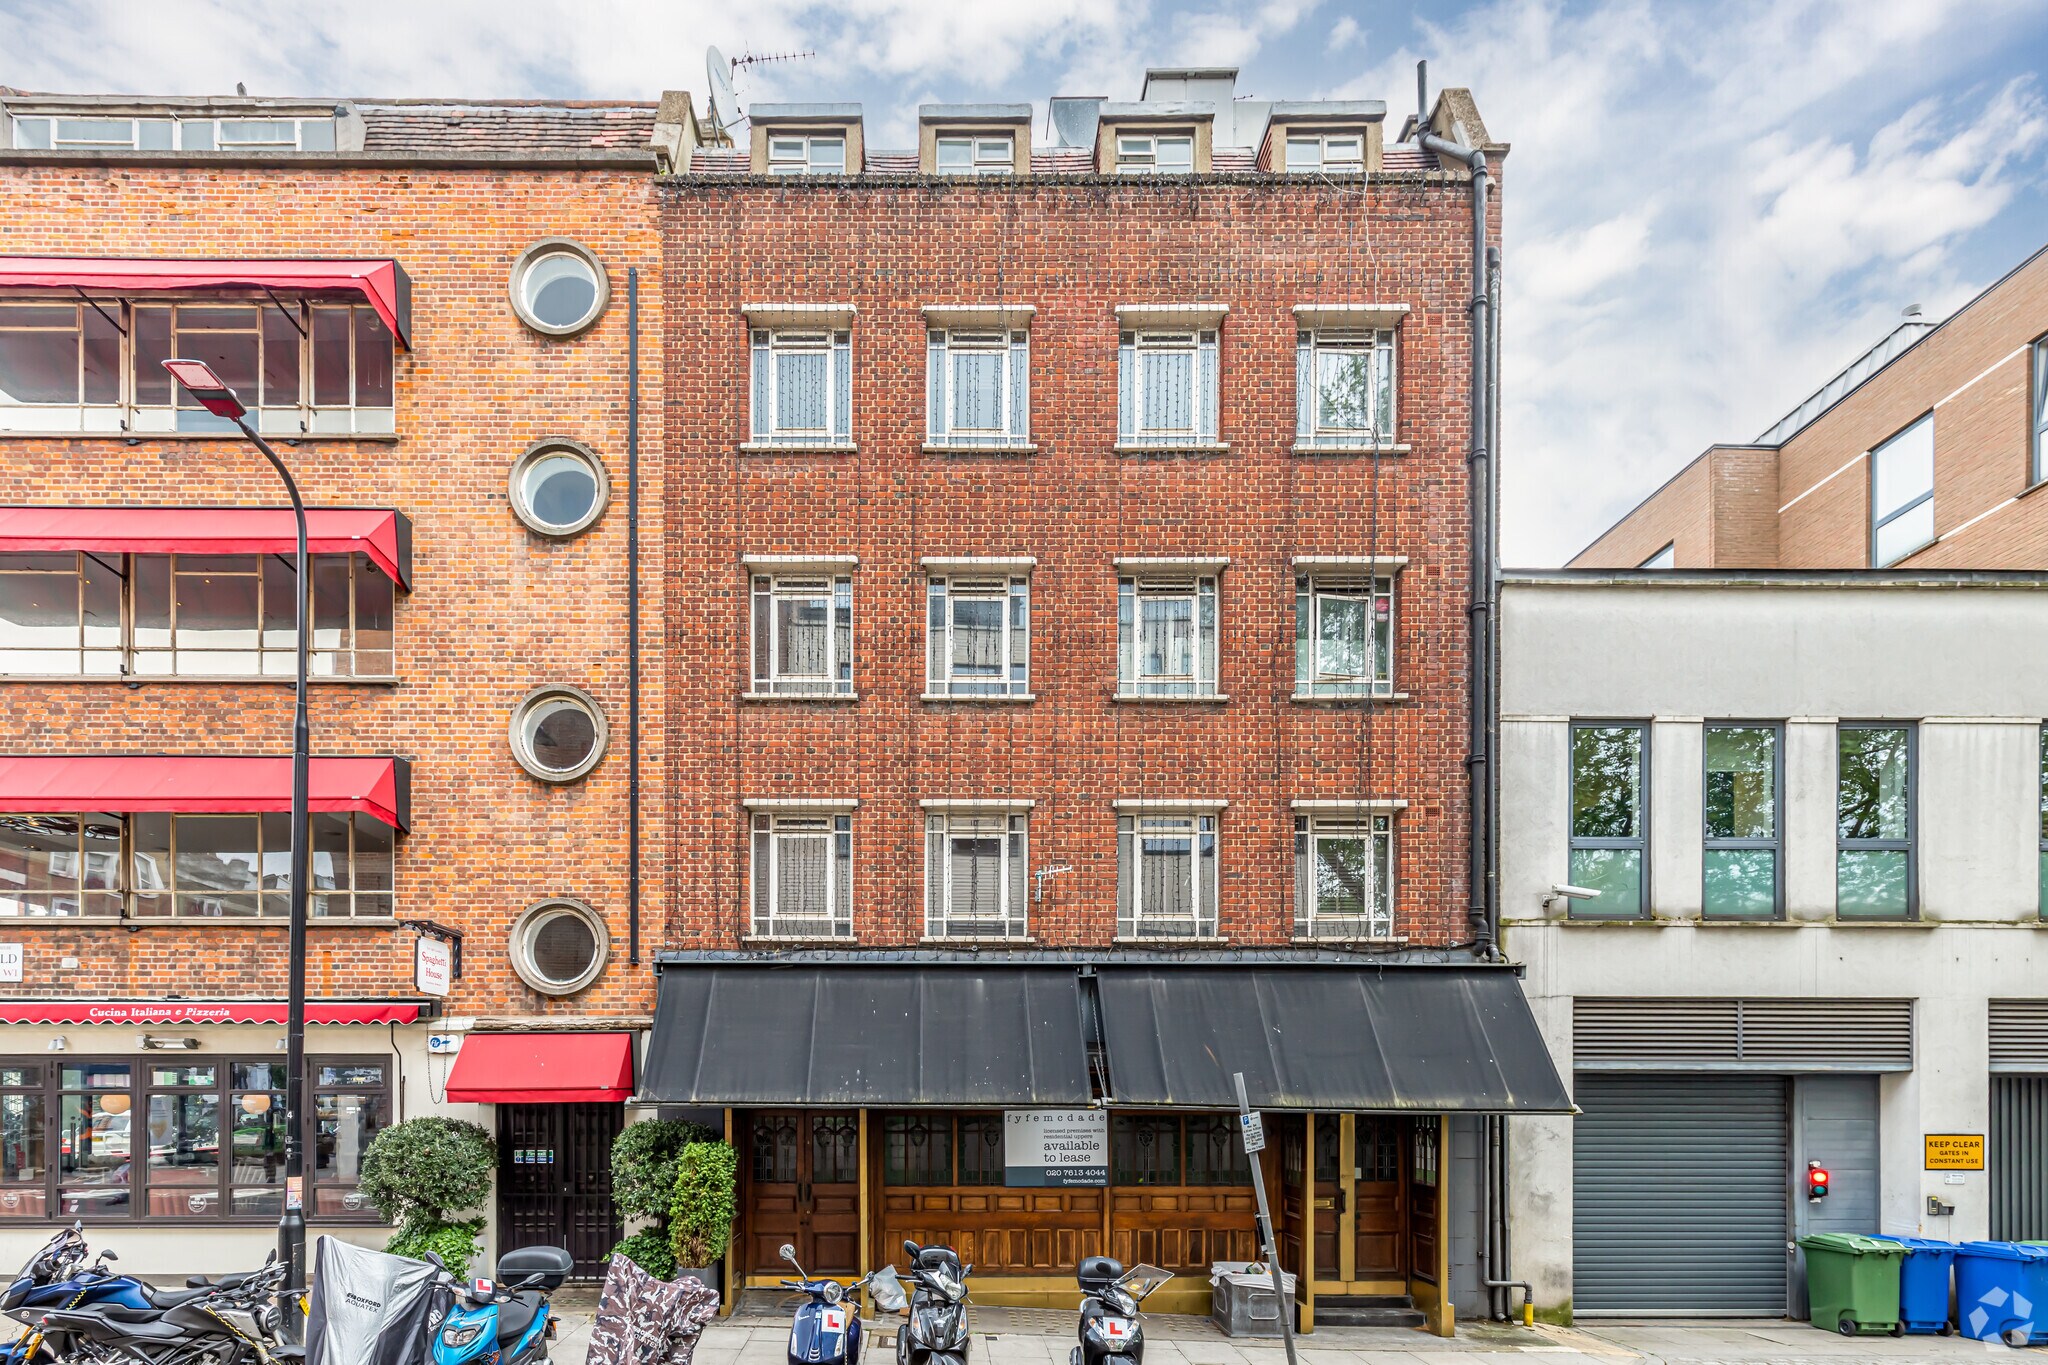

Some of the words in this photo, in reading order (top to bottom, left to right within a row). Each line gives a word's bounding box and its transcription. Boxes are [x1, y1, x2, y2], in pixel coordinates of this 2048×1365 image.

[422, 951, 447, 966] Spaghetti
[426, 967, 442, 980] House
[89, 1008, 127, 1016] Cucina
[130, 1007, 171, 1016] Italiana
[185, 1007, 230, 1016] Pizzeria
[1007, 1114, 1105, 1124] fyfemcdade
[1044, 1141, 1100, 1151] available
[1044, 1154, 1056, 1162] to
[1060, 1153, 1091, 1162] lease
[345, 1298, 378, 1313] AQUATEX
[356, 1297, 381, 1308] OXFORD
[828, 1314, 839, 1328] L
[1110, 1322, 1122, 1335] L
